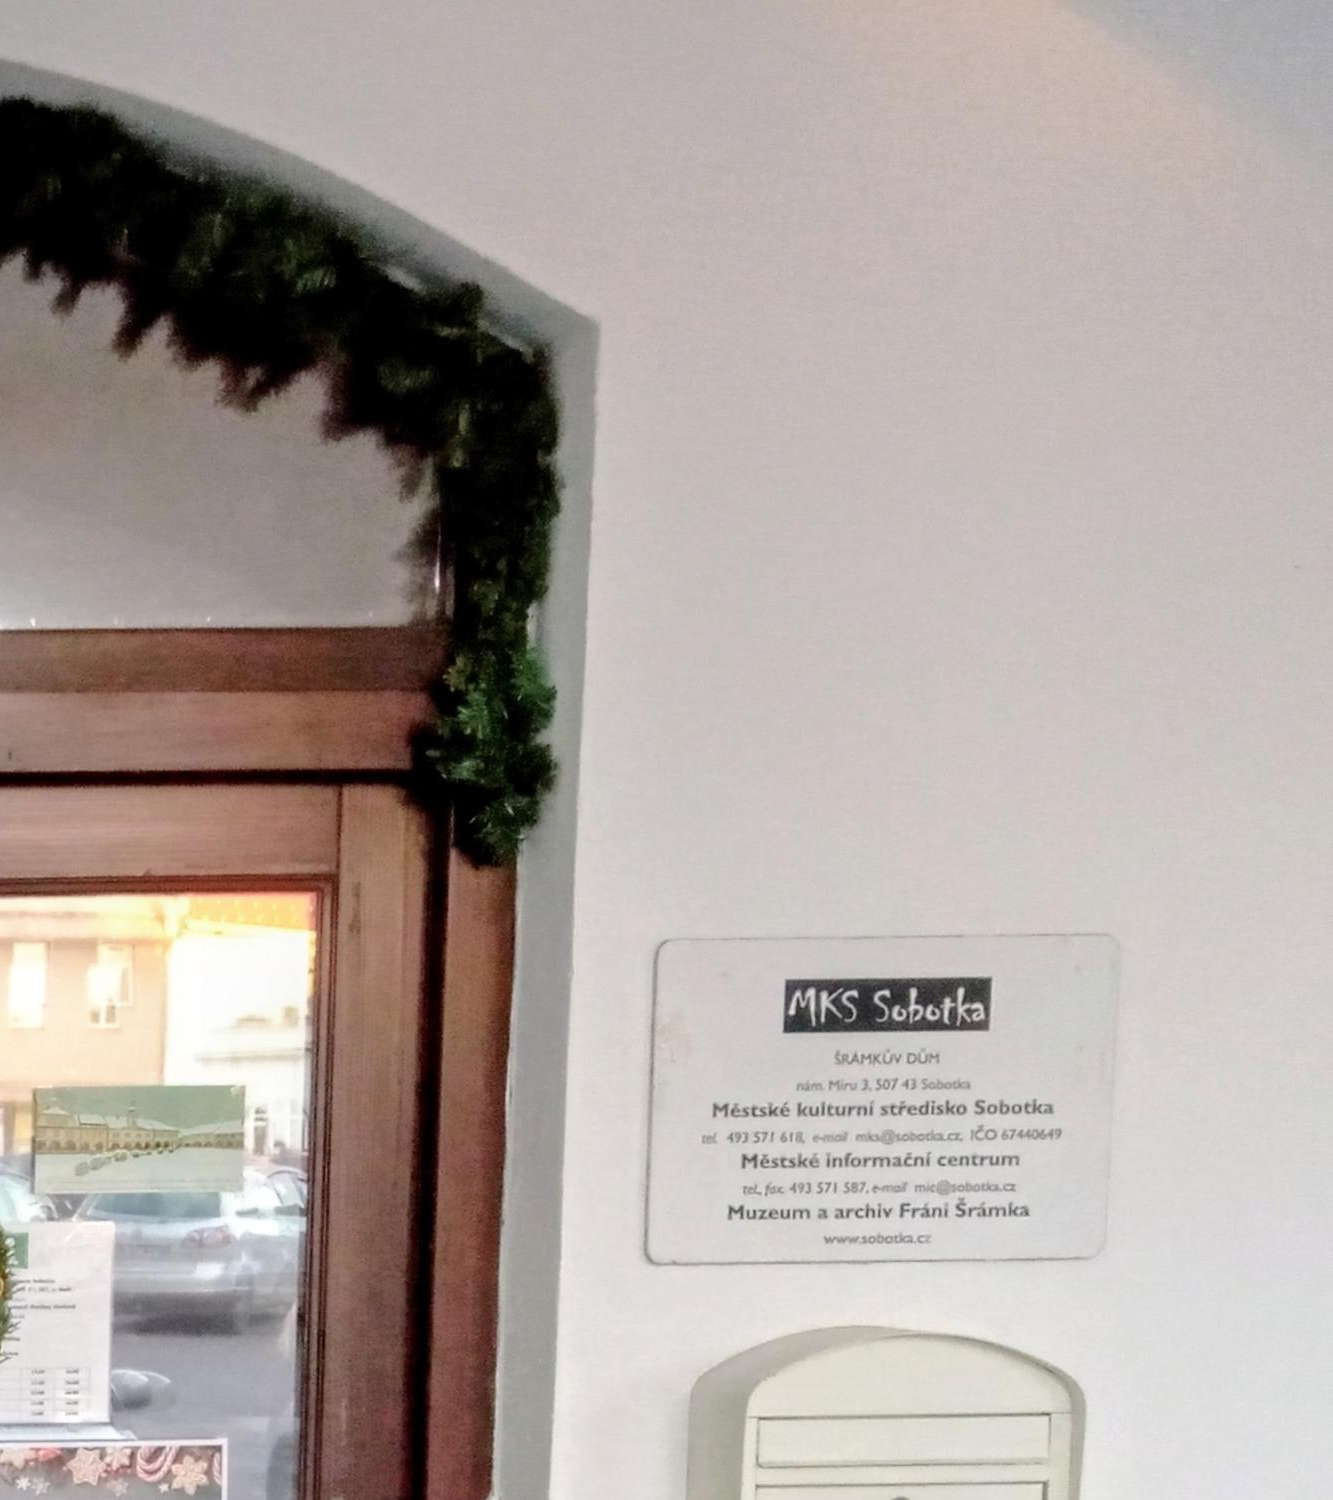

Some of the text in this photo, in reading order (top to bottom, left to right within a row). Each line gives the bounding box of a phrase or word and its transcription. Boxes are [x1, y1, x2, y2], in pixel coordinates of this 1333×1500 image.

[787, 986, 987, 1026] MKS Sobotka
[906, 1048, 940, 1064] DŮM
[875, 1078, 899, 1090] 507
[902, 1078, 917, 1090] 43
[921, 1078, 971, 1090] Sobotka
[712, 1099, 1054, 1118] Městské kulturní středisko Sobotka
[727, 1132, 749, 1143] 493
[753, 1132, 774, 1143] 571
[812, 1132, 848, 1143] e-mail
[970, 1125, 998, 1141] IČO
[1001, 1128, 1062, 1141] 67440649
[741, 1152, 1020, 1169] Městské informační centrum
[789, 1182, 812, 1194] 493
[817, 1182, 837, 1194] 571
[872, 1182, 907, 1193] e-mail
[915, 1180, 1016, 1195] mic@sobotka.cz
[727, 1197, 1030, 1220] Muzeum a archiv Fráni Šrámka
[824, 1232, 931, 1245] www.sobotka.cz
